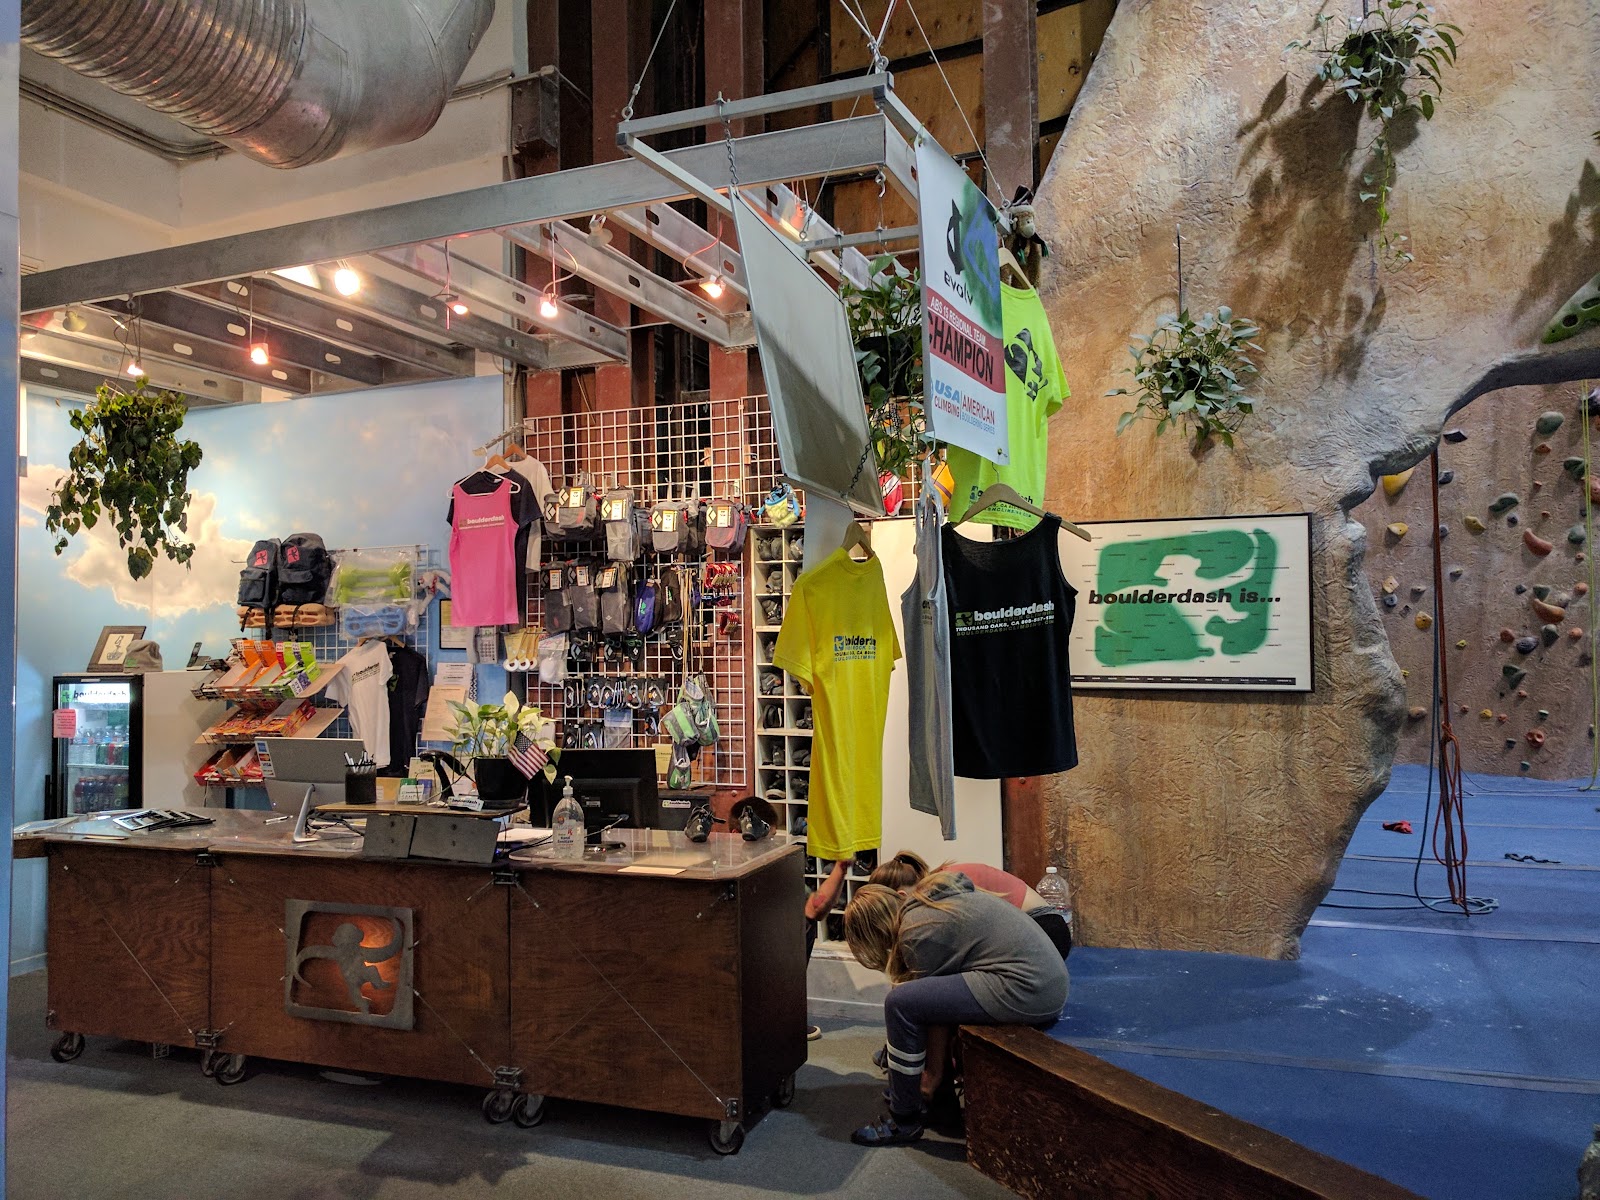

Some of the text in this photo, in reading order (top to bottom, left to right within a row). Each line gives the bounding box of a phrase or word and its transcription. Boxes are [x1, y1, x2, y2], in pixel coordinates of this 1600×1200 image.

[930, 296, 943, 314] ABS
[949, 309, 973, 337] REGIONAL
[973, 328, 986, 346] TEAM
[935, 379, 960, 404] USA
[934, 395, 960, 418] CLIMBING
[961, 394, 995, 425] AMERICAN
[1088, 587, 1281, 606] boulderdash is...
[974, 600, 1055, 622] boulderdash
